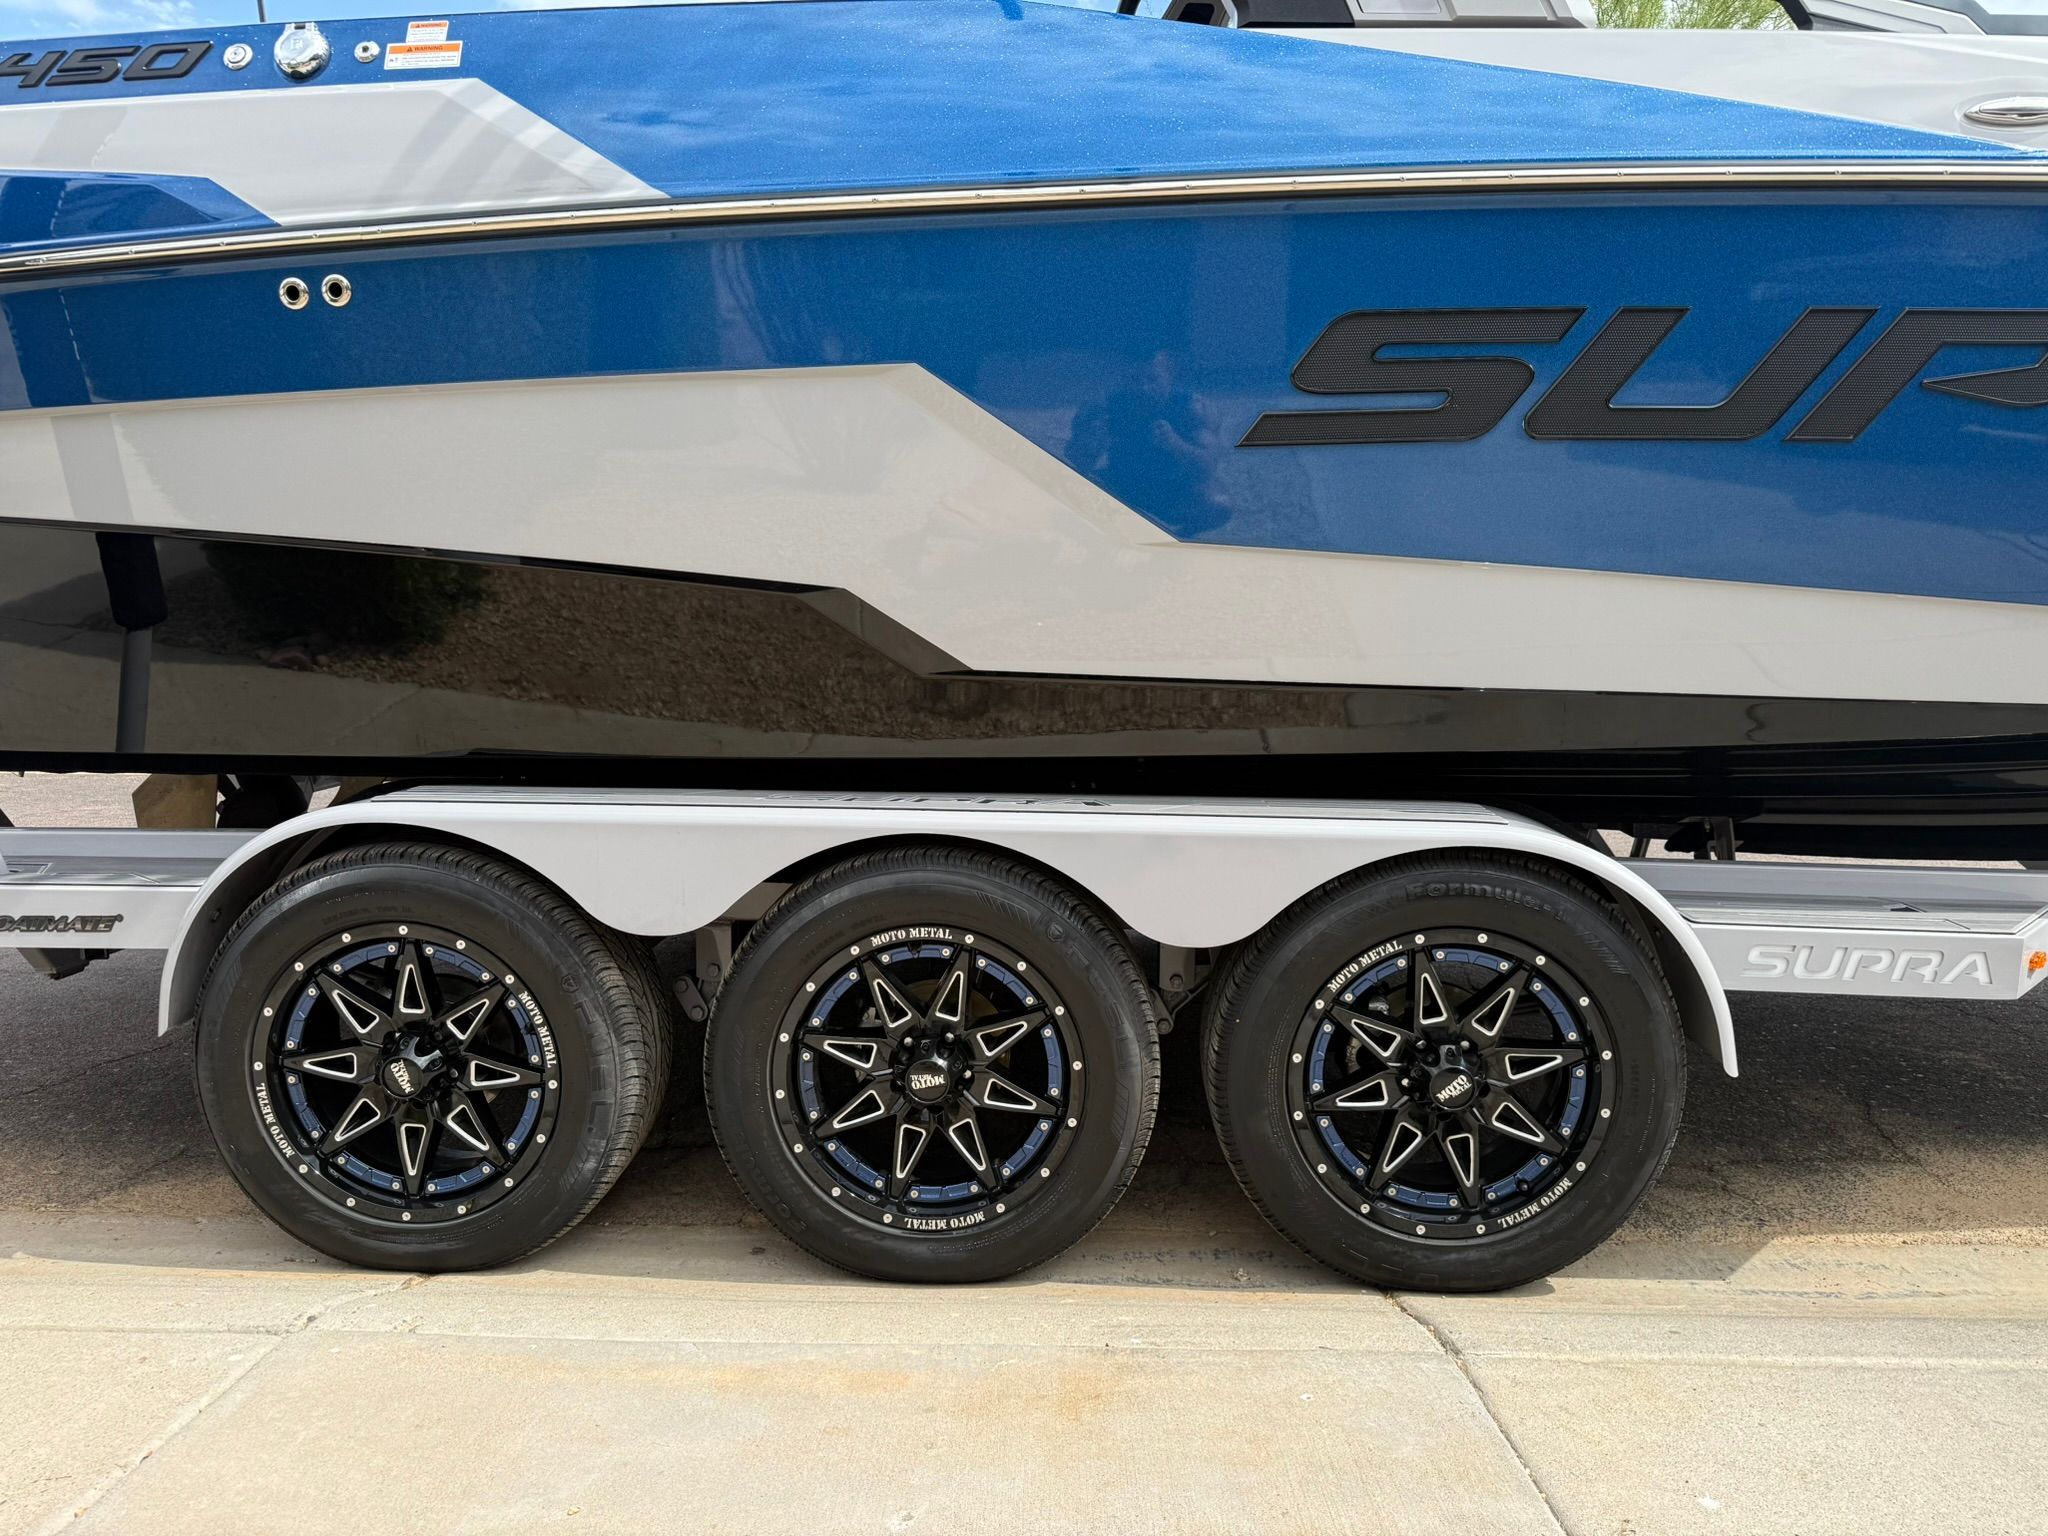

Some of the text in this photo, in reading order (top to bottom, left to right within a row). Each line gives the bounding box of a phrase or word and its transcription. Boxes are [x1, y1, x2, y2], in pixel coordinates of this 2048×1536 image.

[0, 40, 214, 88] 450
[870, 927, 952, 947] MOTO METAL
[1327, 940, 1402, 992] MOTO METAL
[1739, 944, 1993, 985] SUPRA
[518, 990, 556, 1068] MOTO METAL
[391, 1062, 414, 1094] MOTO
[911, 1074, 946, 1090] MOTO
[1436, 1075, 1467, 1102] MOTO
[255, 1082, 295, 1158] MOTO METAL
[904, 1211, 986, 1230] MOTO METAL
[1497, 1177, 1572, 1228] MOTO METAL
